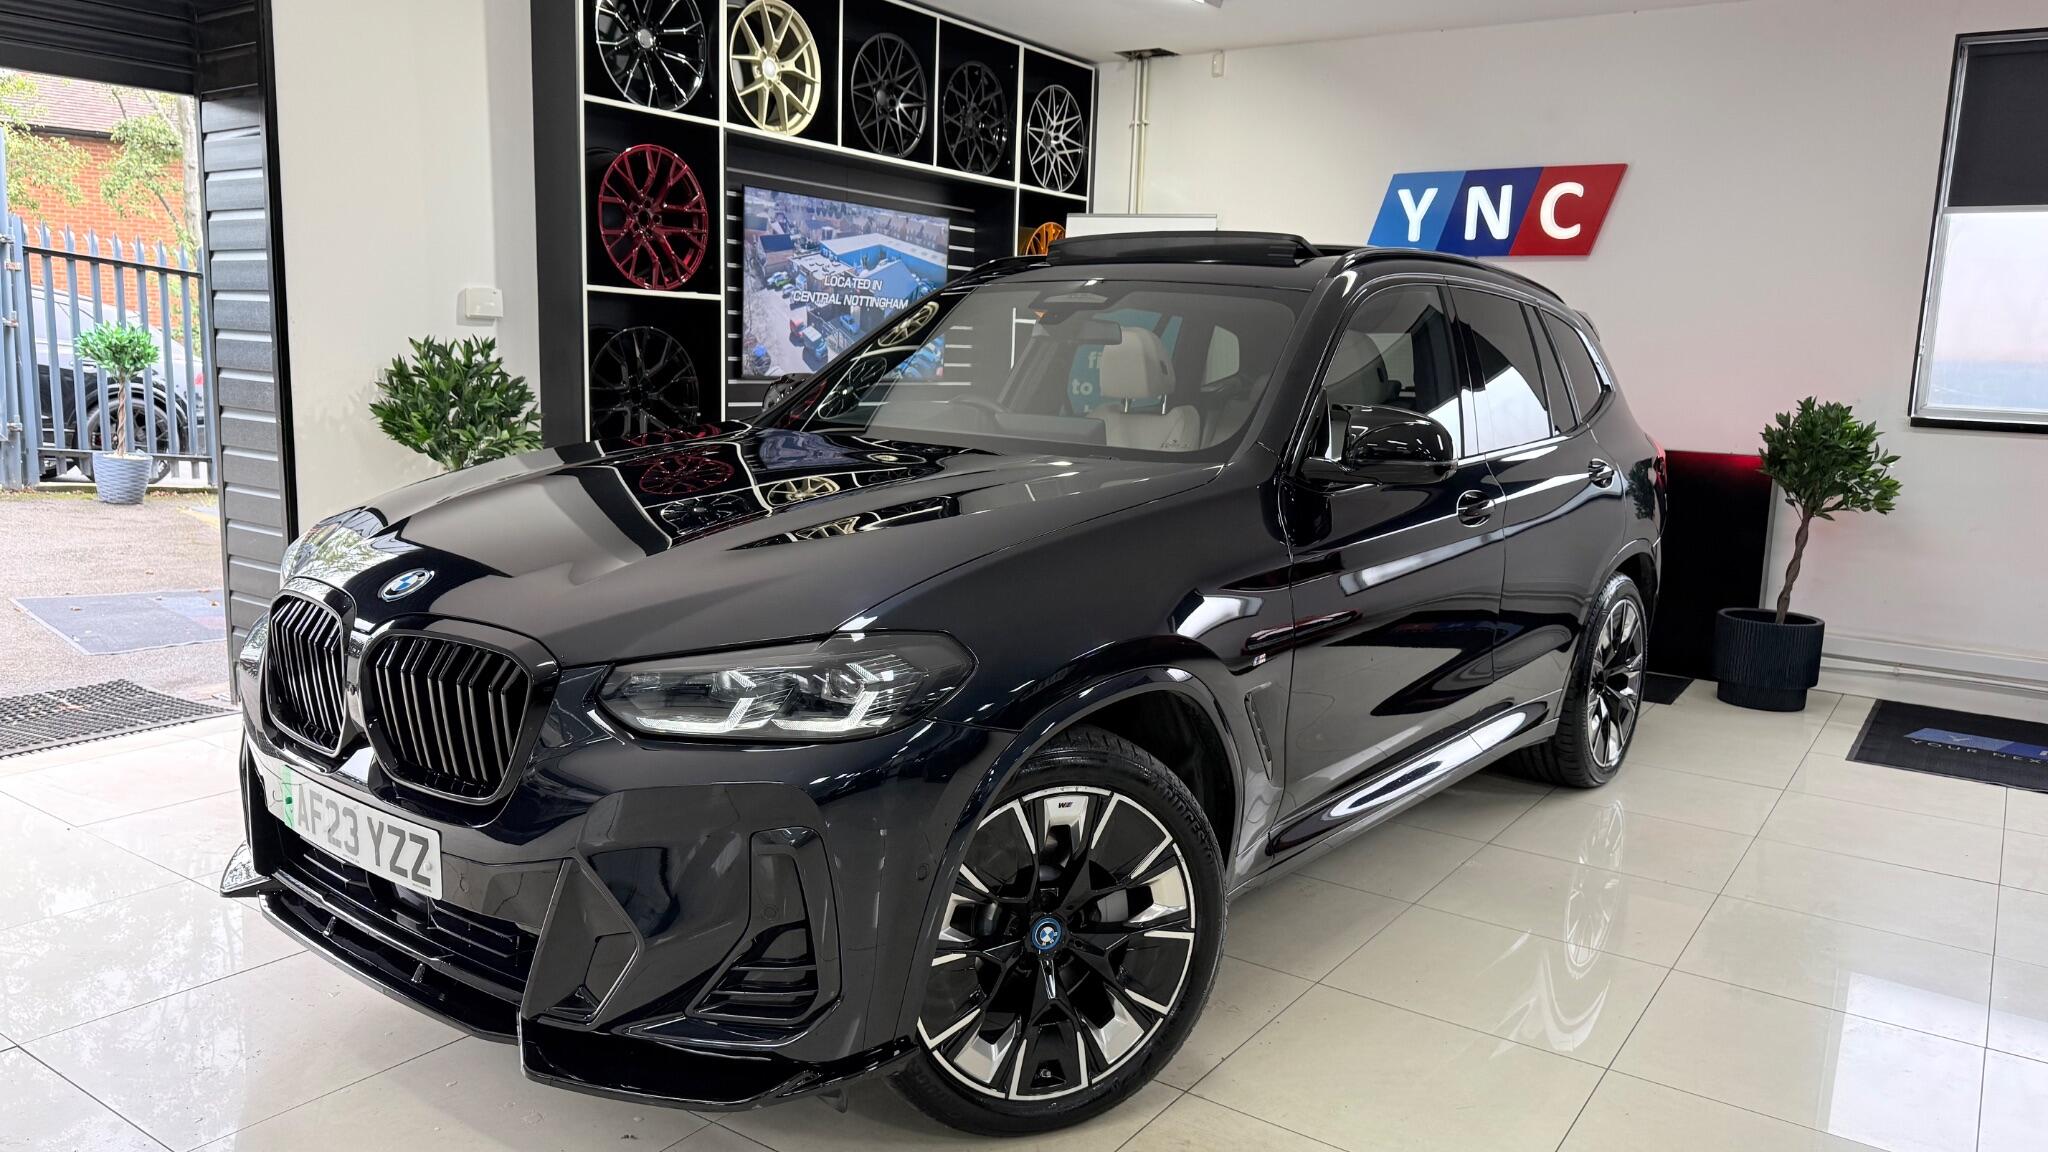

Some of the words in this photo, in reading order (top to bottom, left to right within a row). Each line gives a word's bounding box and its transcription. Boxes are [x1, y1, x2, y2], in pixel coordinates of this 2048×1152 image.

[1397, 181, 1584, 242] YNC
[824, 275, 870, 290] LOCATED
[872, 279, 883, 291] IN
[793, 290, 841, 305] CENTRAL
[843, 294, 909, 309] NOTTINGHAM
[1071, 379, 1093, 395] to
[1911, 739, 1978, 753] YOUR
[1992, 752, 2048, 765] NEX
[298, 783, 360, 857] AF23
[366, 815, 432, 887] YZZ
